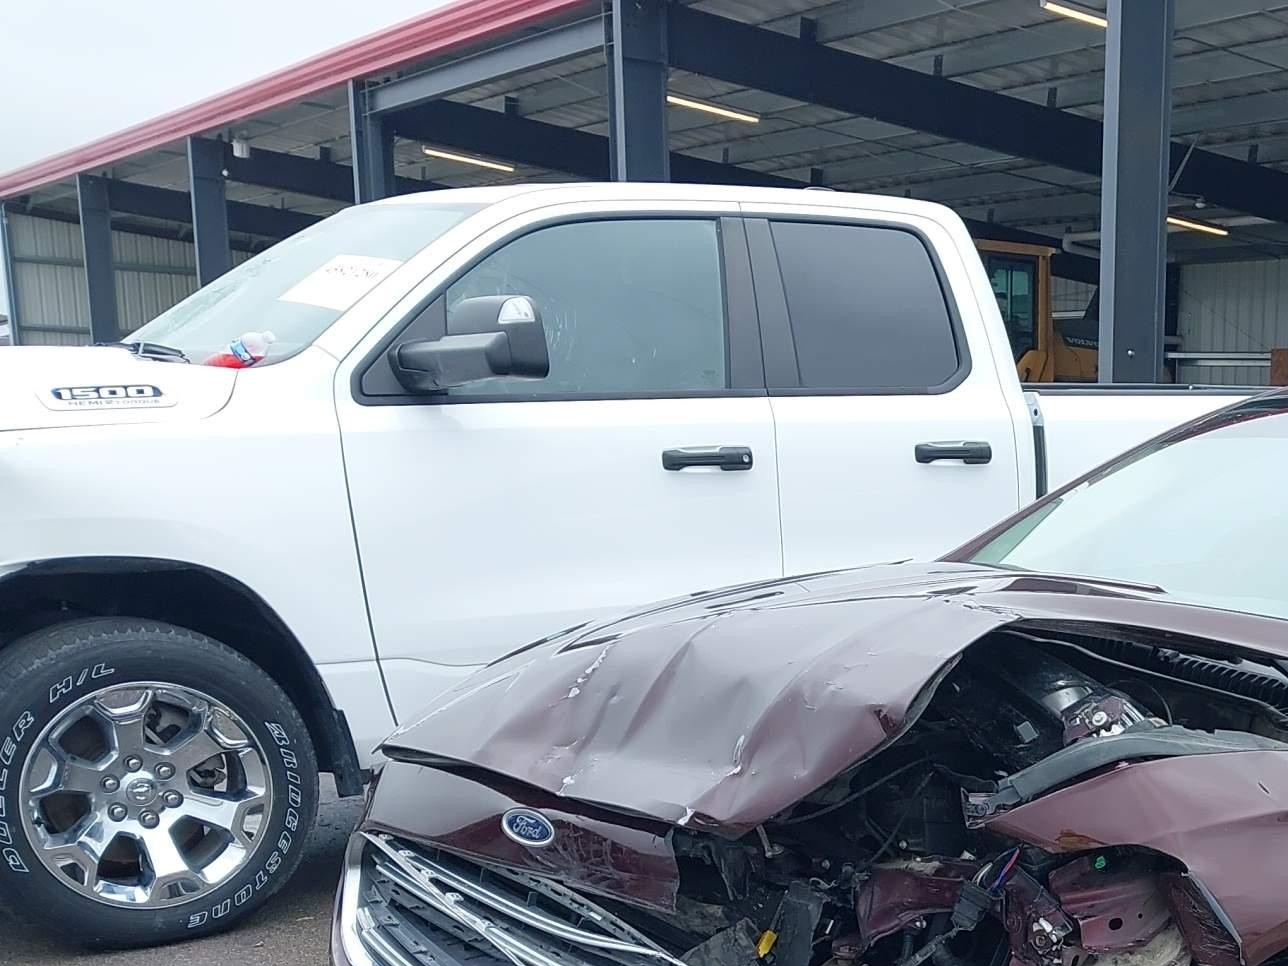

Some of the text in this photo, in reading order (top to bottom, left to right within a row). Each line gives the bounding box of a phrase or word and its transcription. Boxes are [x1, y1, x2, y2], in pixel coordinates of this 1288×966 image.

[55, 385, 155, 400] 1500
[0, 663, 116, 873] DUER H/L
[187, 721, 302, 928] BRIDGESTONE
